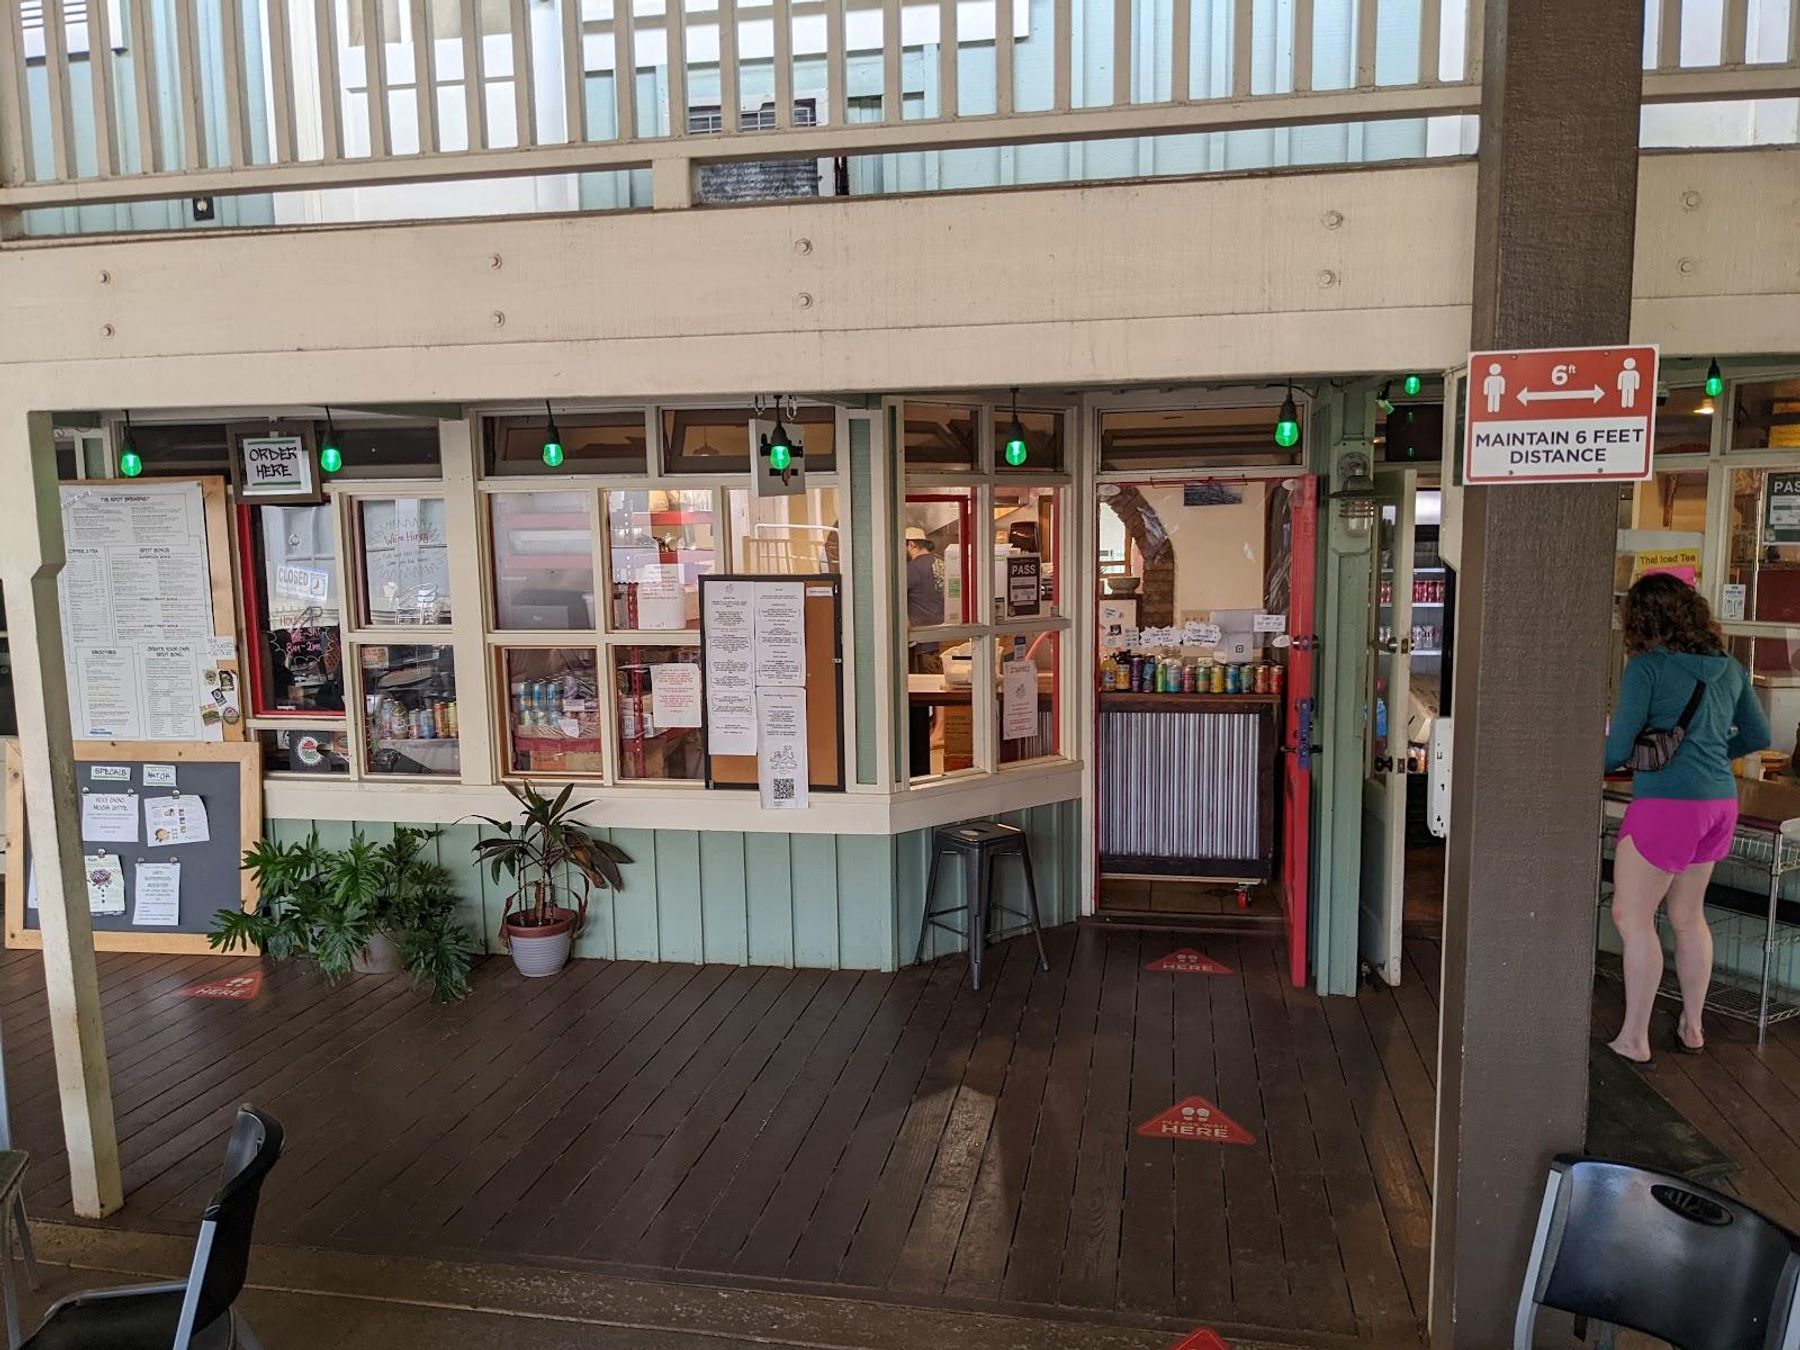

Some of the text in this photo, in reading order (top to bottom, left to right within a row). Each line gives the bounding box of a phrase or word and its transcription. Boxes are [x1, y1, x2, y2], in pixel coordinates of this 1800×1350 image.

[1475, 428, 1644, 448] MAINTAIN 6 FEET
[249, 446, 297, 461] ORDER
[1510, 448, 1607, 464] DISTANCE
[256, 464, 292, 480] HERE
[1640, 553, 1696, 565] Thai Iced Tea
[1012, 564, 1036, 575] PASS
[278, 567, 309, 586] CLOSED
[95, 767, 128, 777] SPECIALS
[1162, 963, 1214, 972] HERE
[195, 986, 246, 997] HERE
[1161, 1125, 1230, 1138] HERE
